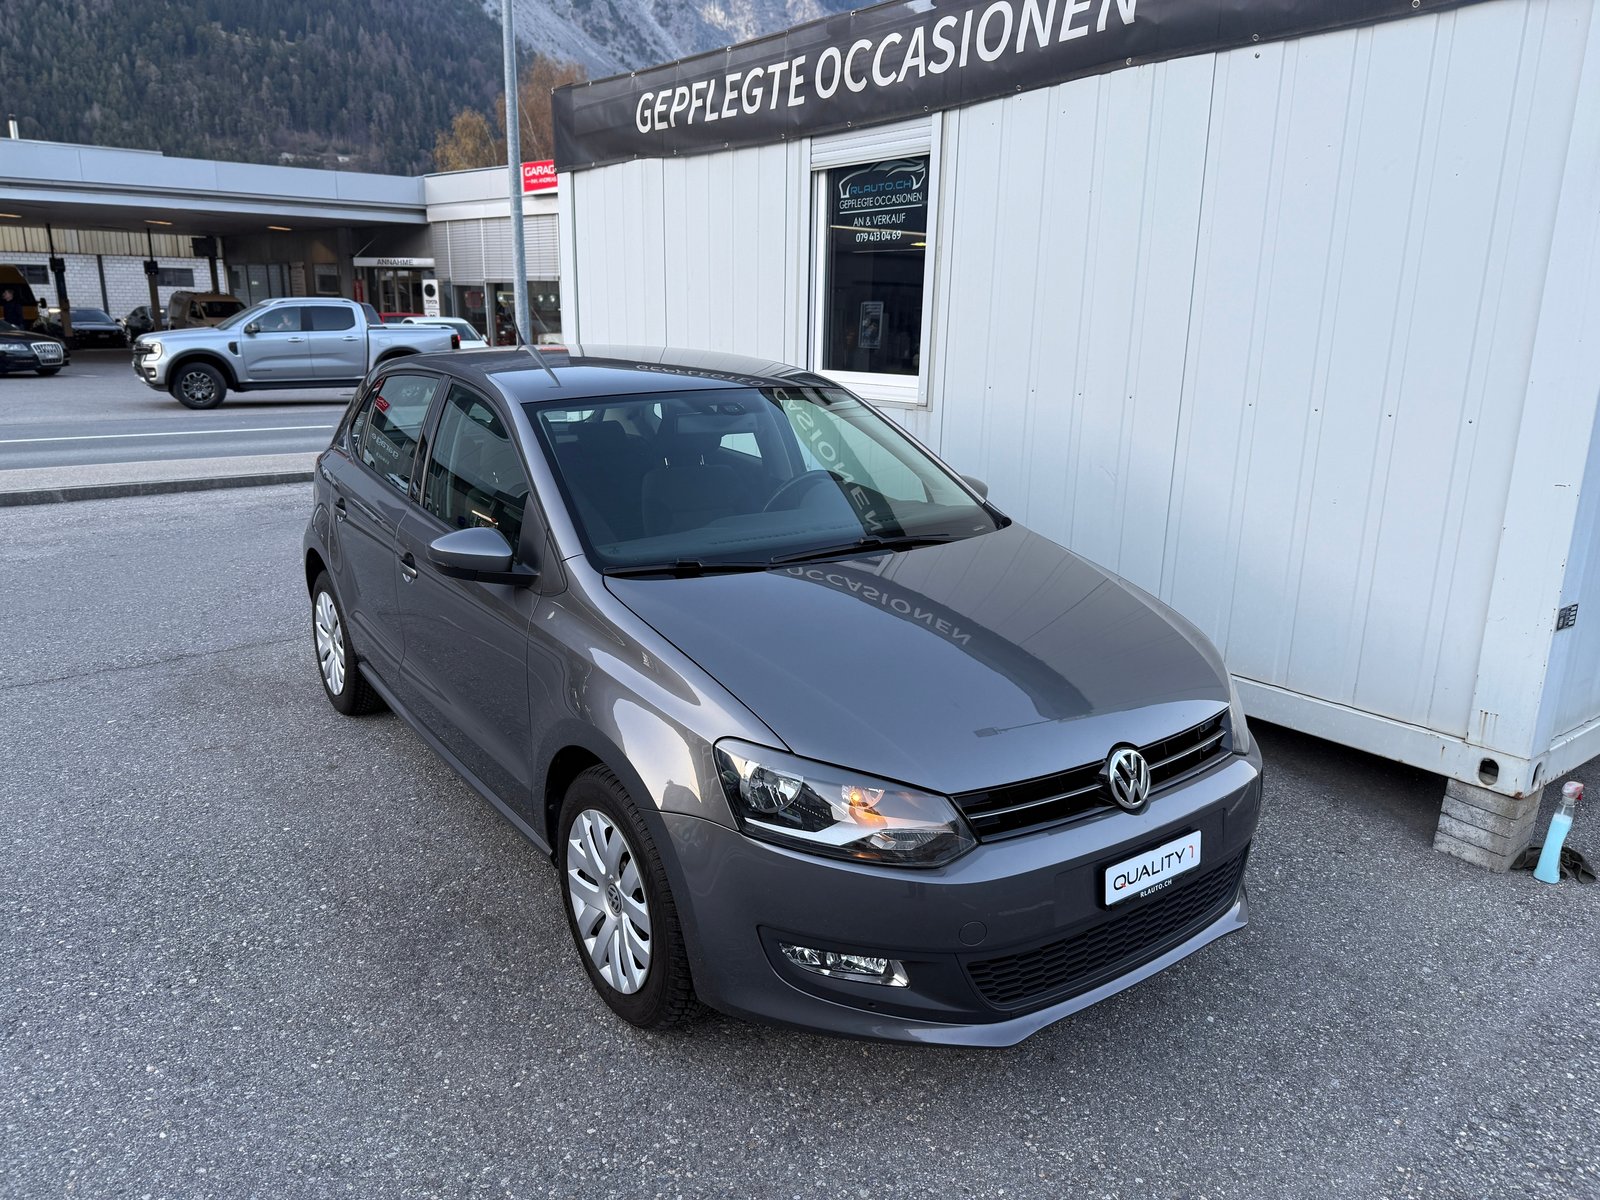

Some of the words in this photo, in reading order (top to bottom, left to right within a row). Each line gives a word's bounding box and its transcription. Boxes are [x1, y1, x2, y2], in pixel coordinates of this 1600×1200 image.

[635, 55, 807, 134] GEPFLEGTE
[850, 180, 912, 195] RLAUTO.CH
[839, 197, 873, 210] GEPFLEGTE
[874, 192, 923, 206] OCCASIONEN
[853, 217, 865, 227] AN
[865, 216, 871, 226] &
[872, 212, 906, 226] VERKAUF
[855, 232, 868, 243] 079
[869, 231, 880, 241] 413
[881, 231, 891, 241] 04
[892, 230, 902, 240] 69
[377, 258, 414, 266] ANNAHME
[1113, 847, 1186, 891] QUALITY
[1140, 879, 1173, 898] RLAUTO.CH
